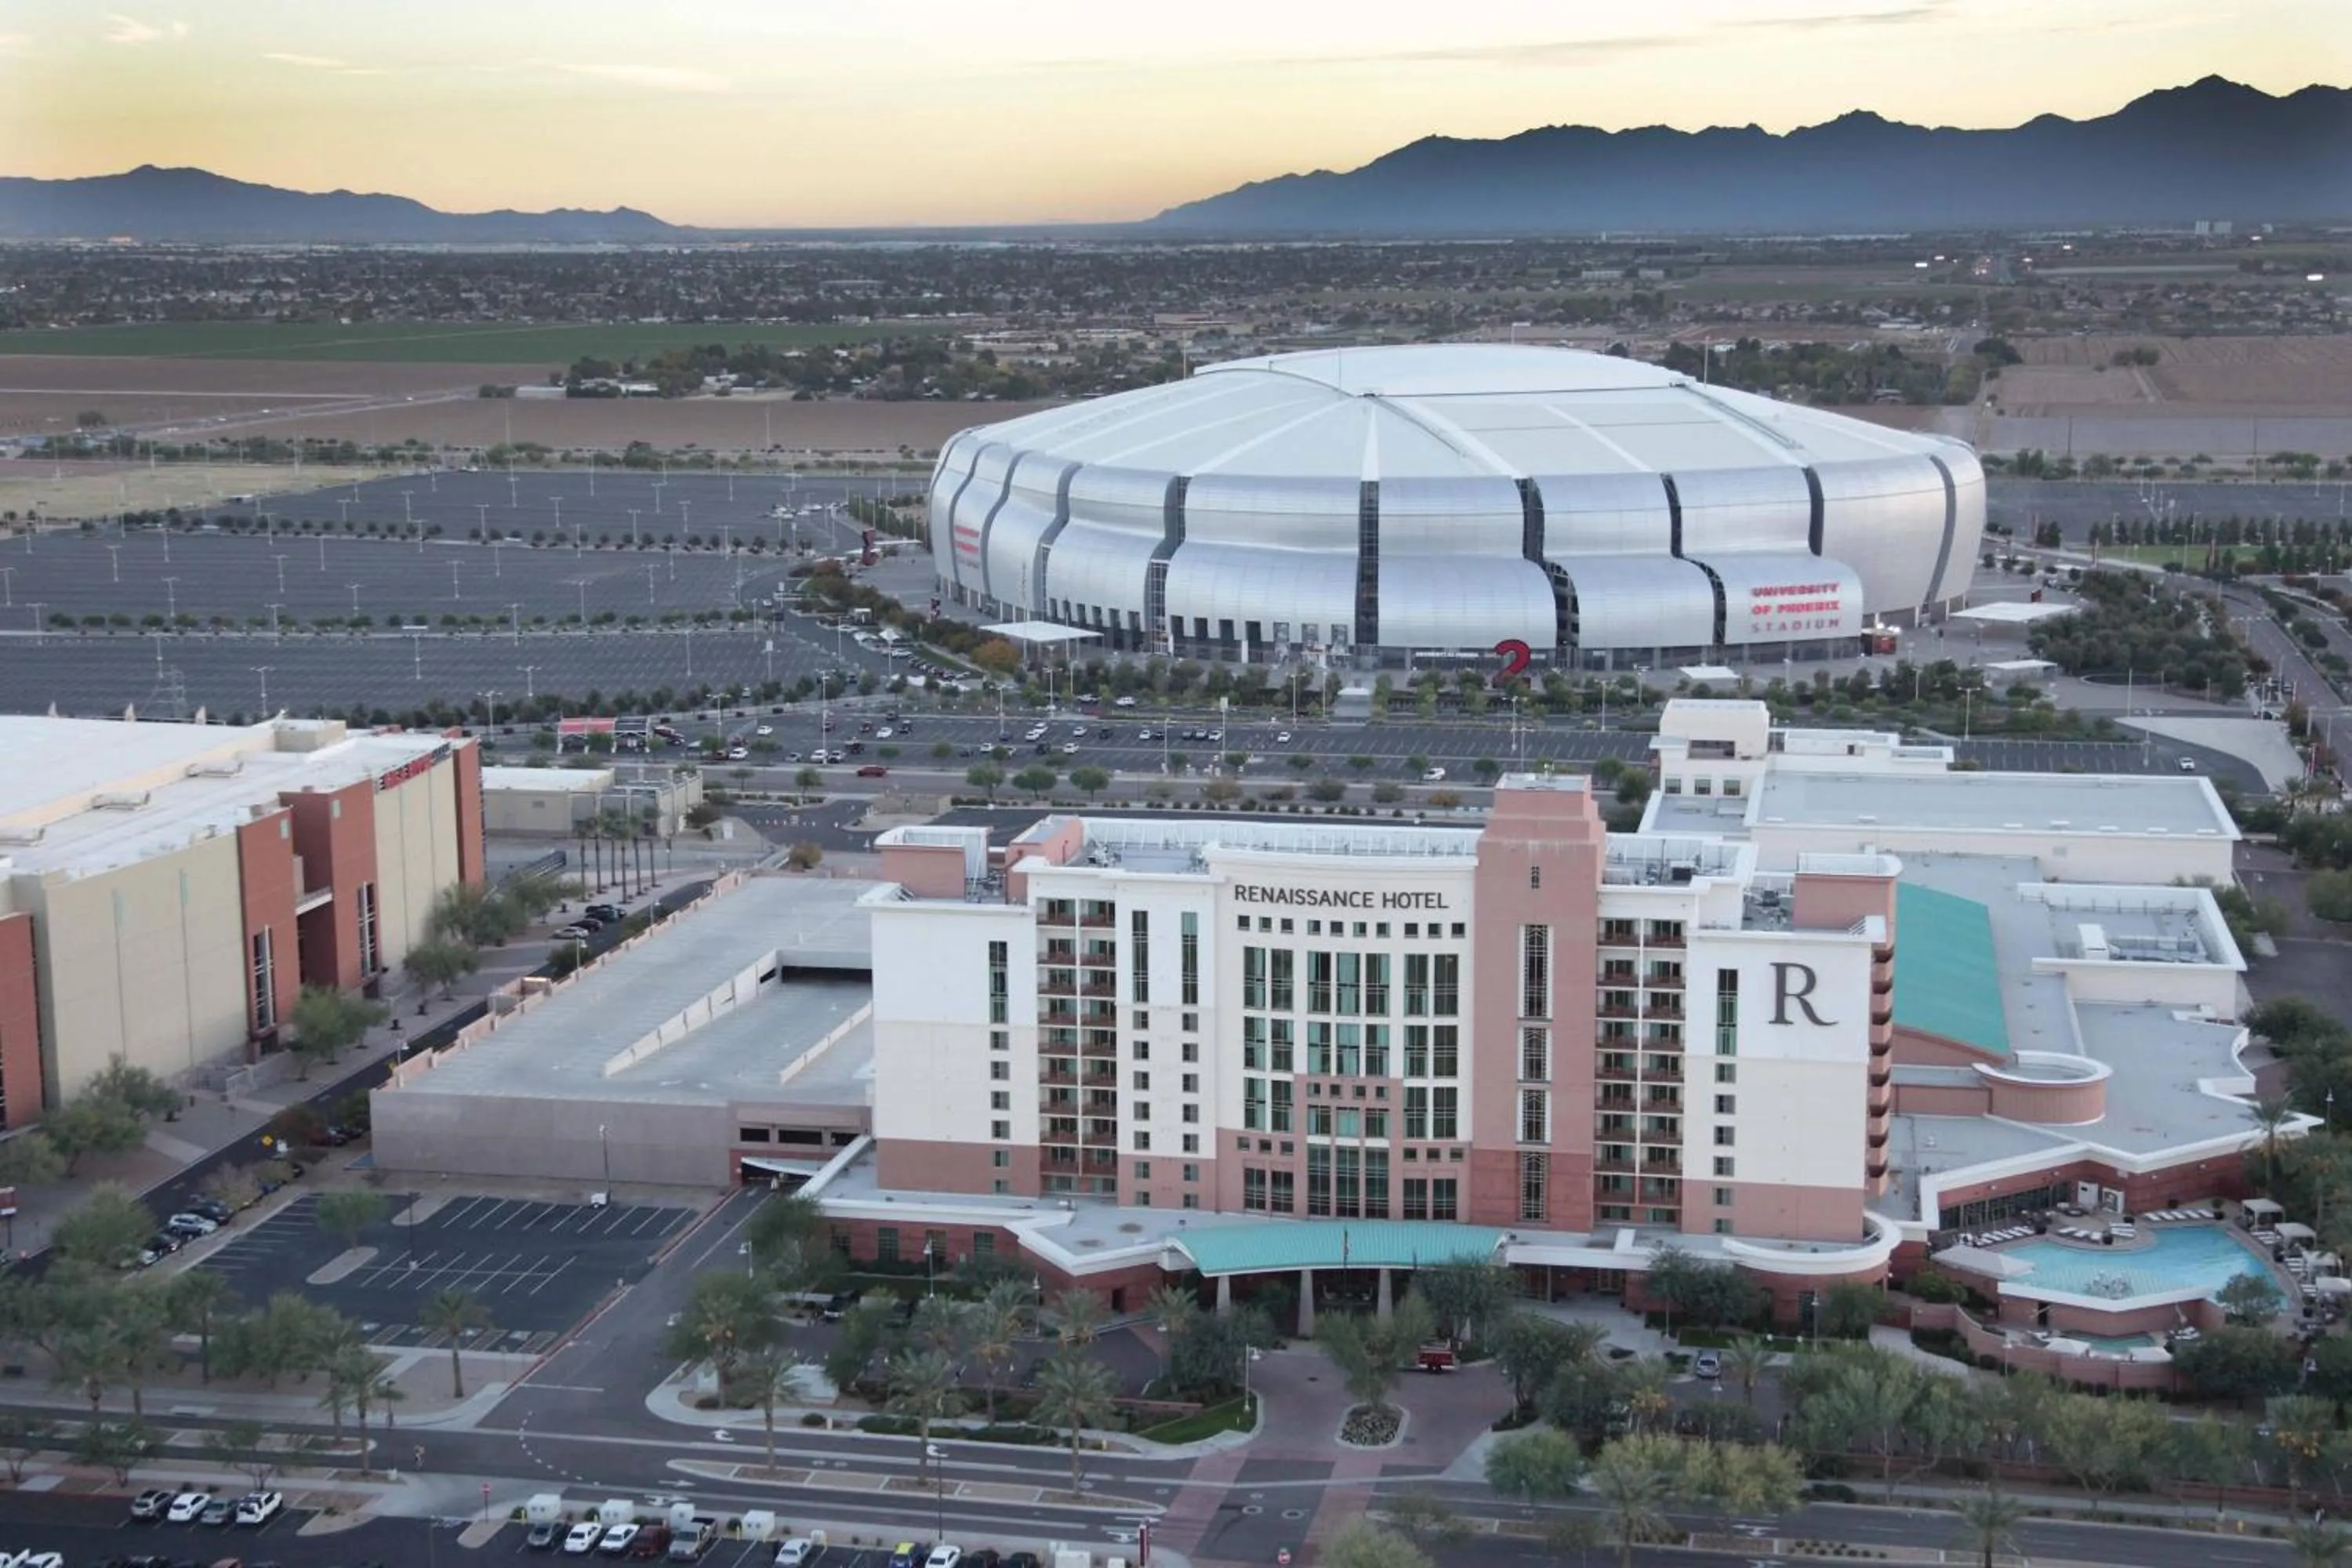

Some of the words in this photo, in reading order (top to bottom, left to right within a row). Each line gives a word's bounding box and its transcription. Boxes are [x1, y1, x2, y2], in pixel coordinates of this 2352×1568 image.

[1751, 583, 1839, 597] UNIVERSITY
[1751, 604, 1772, 615] OF
[1777, 601, 1839, 613] PHOENIX
[1752, 619, 1839, 633] STADIUM
[1234, 884, 1374, 908] RENAISSANCE
[1382, 891, 1449, 909] HOTEL
[1768, 962, 1839, 1026] R
